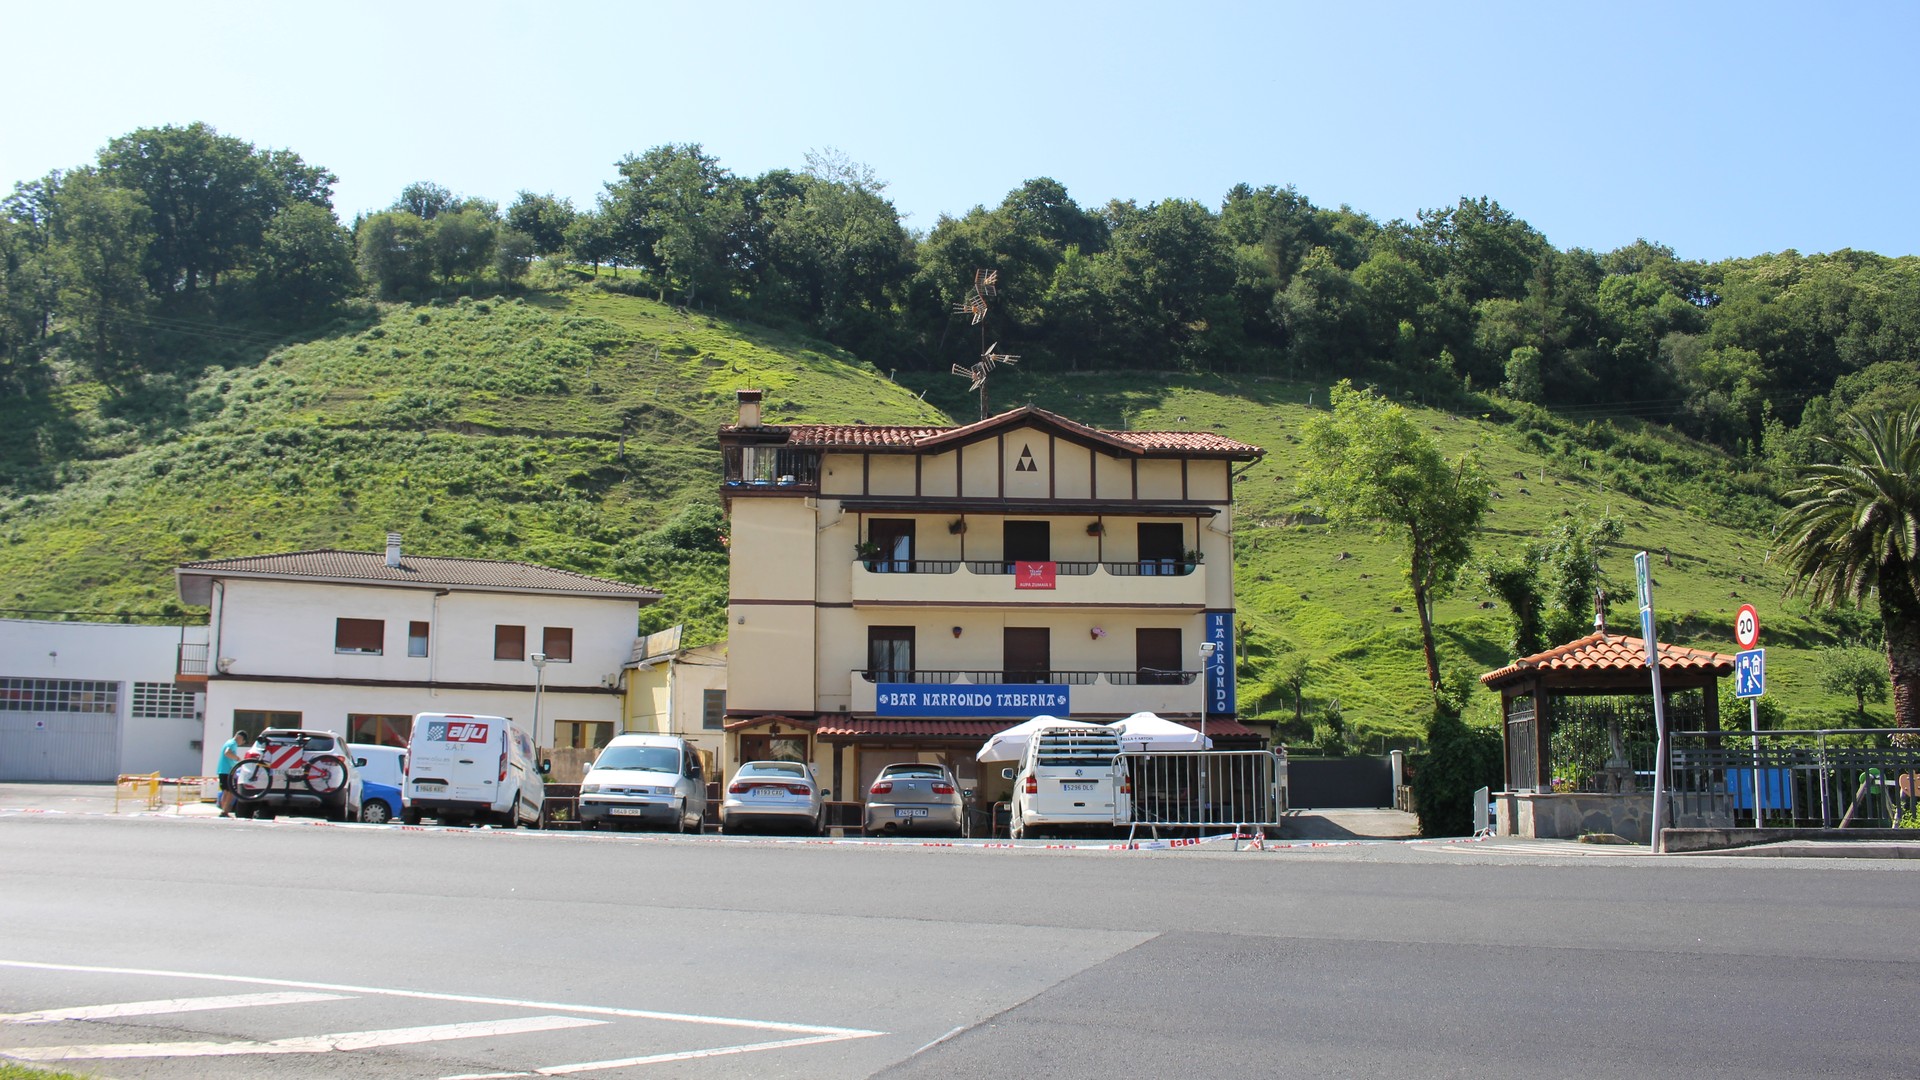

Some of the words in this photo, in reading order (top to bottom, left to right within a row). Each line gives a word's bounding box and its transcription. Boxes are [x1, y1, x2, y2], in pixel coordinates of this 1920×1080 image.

[1740, 618, 1752, 634] 20
[1215, 616, 1226, 711] NARRONDO
[890, 693, 916, 706] BAR
[923, 693, 992, 707] NARRONDO
[997, 693, 1055, 707] TABERNA
[448, 724, 486, 741] alju
